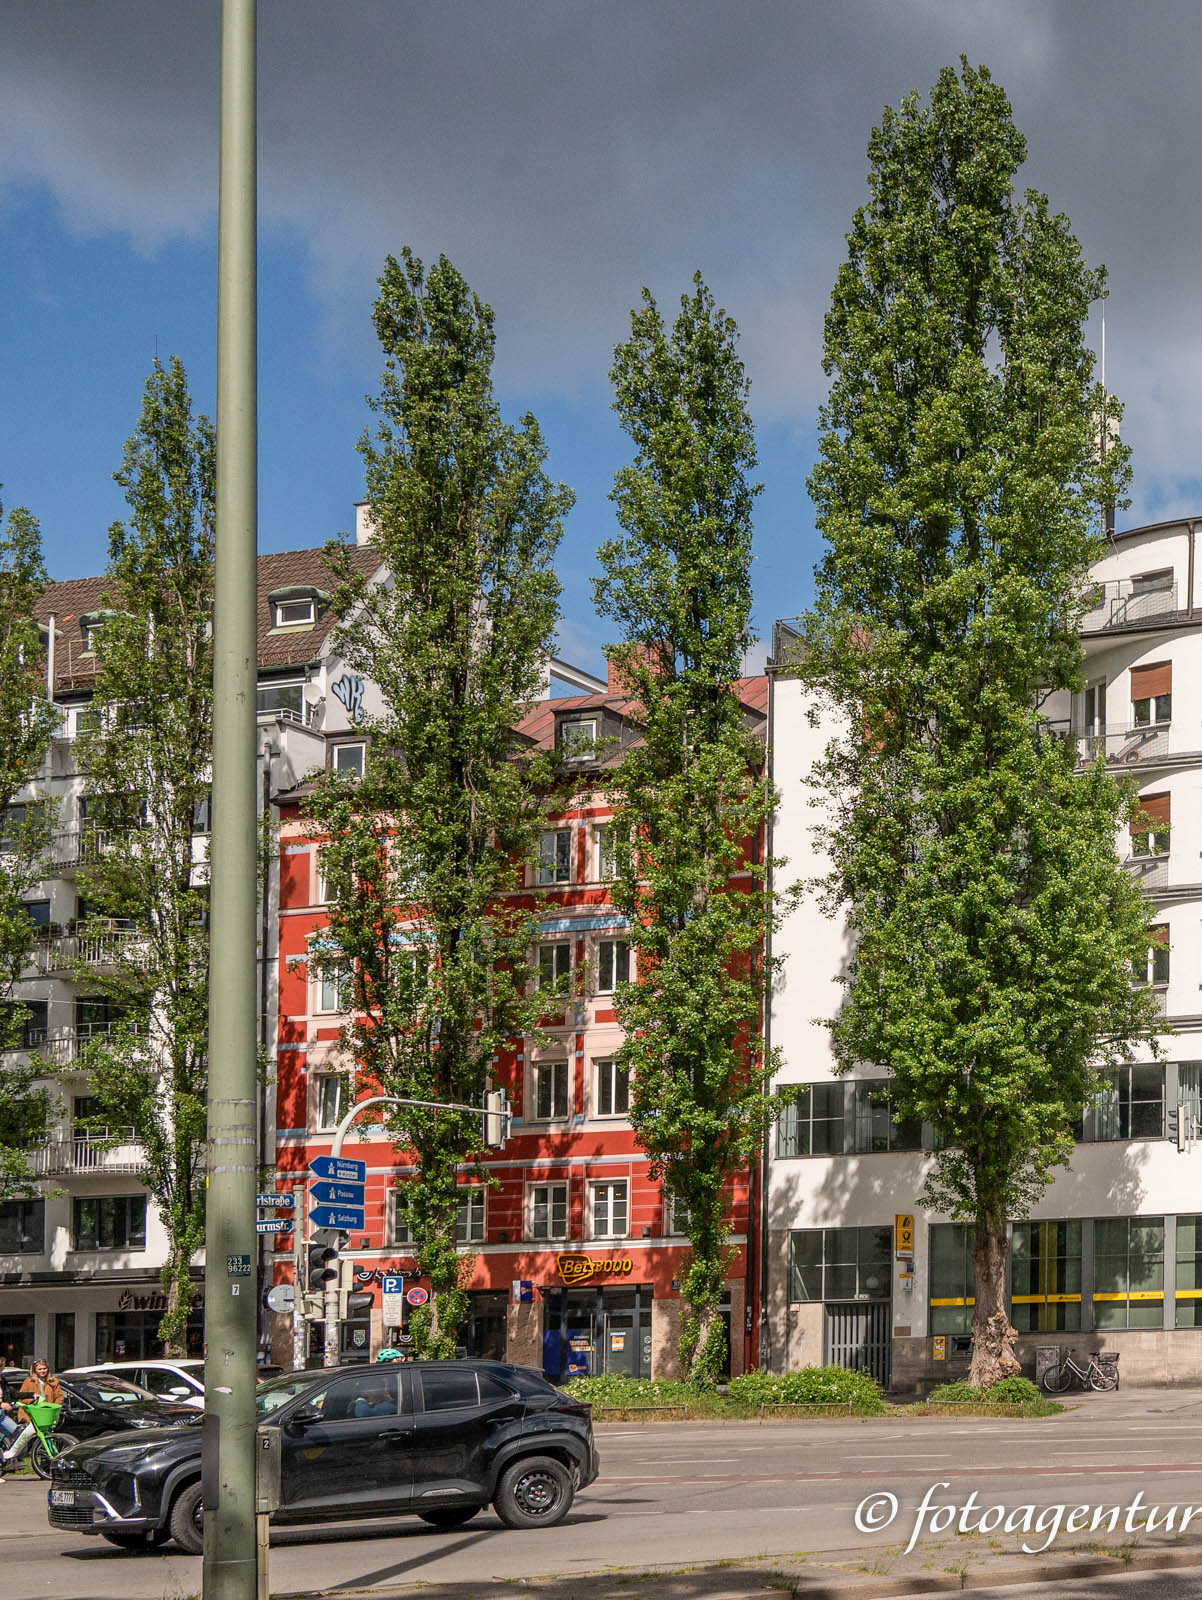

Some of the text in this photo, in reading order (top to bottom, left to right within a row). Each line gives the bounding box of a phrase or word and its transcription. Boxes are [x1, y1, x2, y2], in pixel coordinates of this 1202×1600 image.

[337, 1161, 358, 1171] Nürnberg
[256, 1195, 290, 1207] rlstraße
[337, 1214, 358, 1224] Salzburg
[256, 1221, 289, 1232] urmstr.
[385, 1279, 397, 1292] P
[263, 1439, 270, 1449] 2
